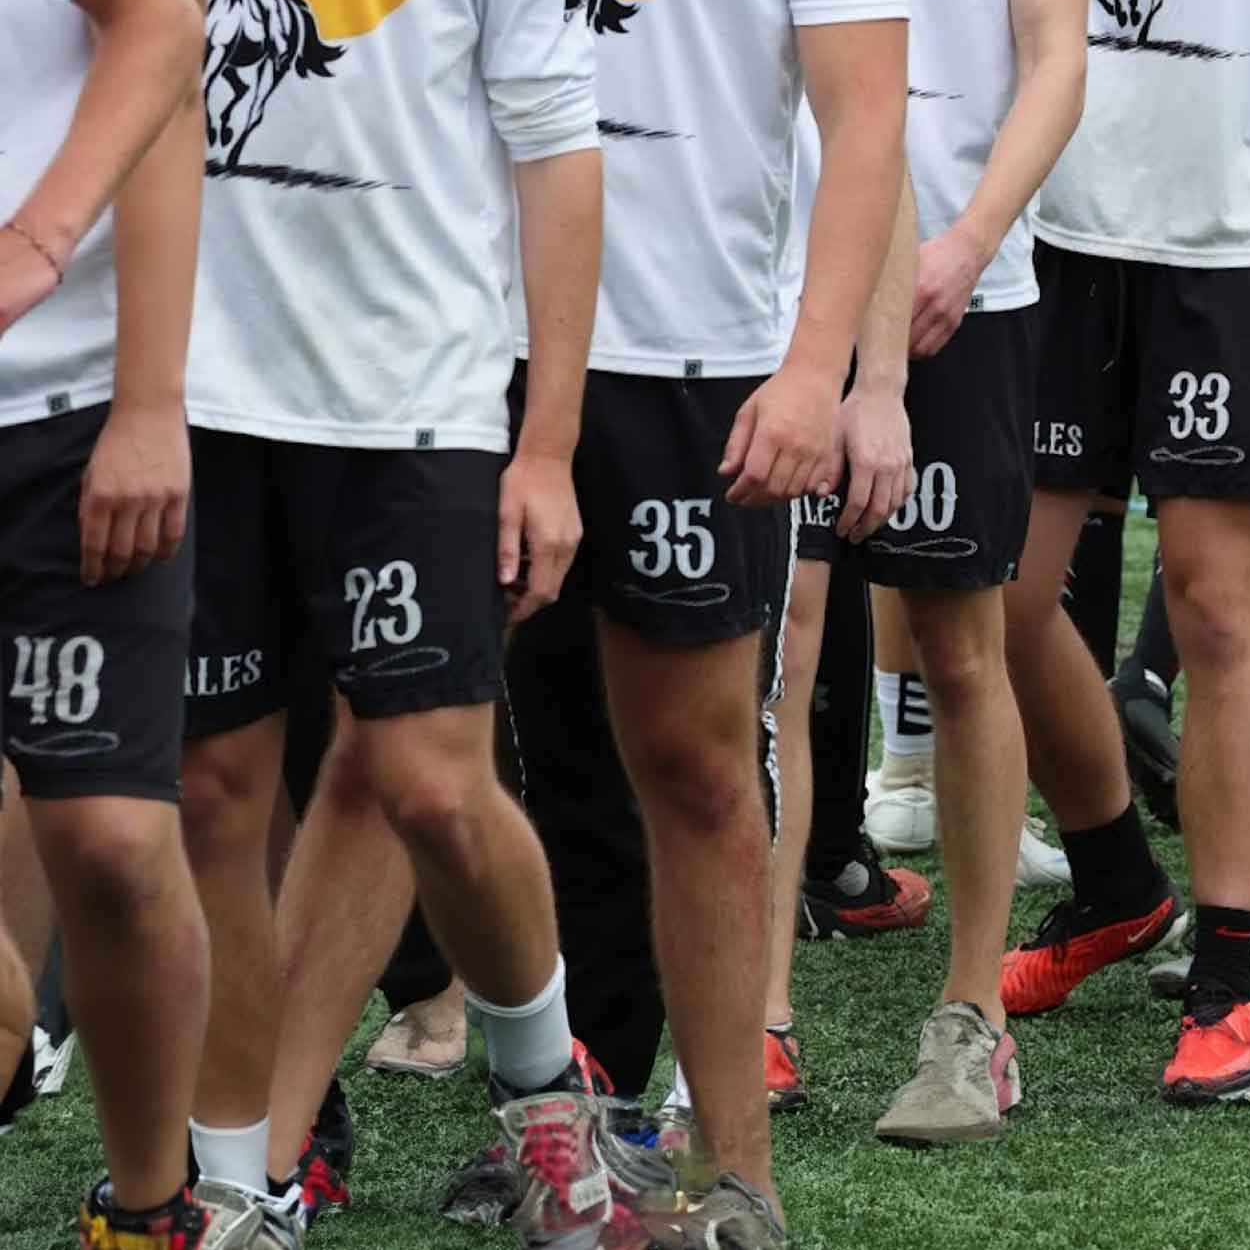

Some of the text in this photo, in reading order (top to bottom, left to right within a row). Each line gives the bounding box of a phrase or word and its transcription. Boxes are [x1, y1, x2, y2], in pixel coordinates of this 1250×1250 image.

[1168, 371, 1230, 441] 33
[629, 499, 715, 579] 35
[344, 559, 423, 652] 23
[9, 636, 104, 725] 48
